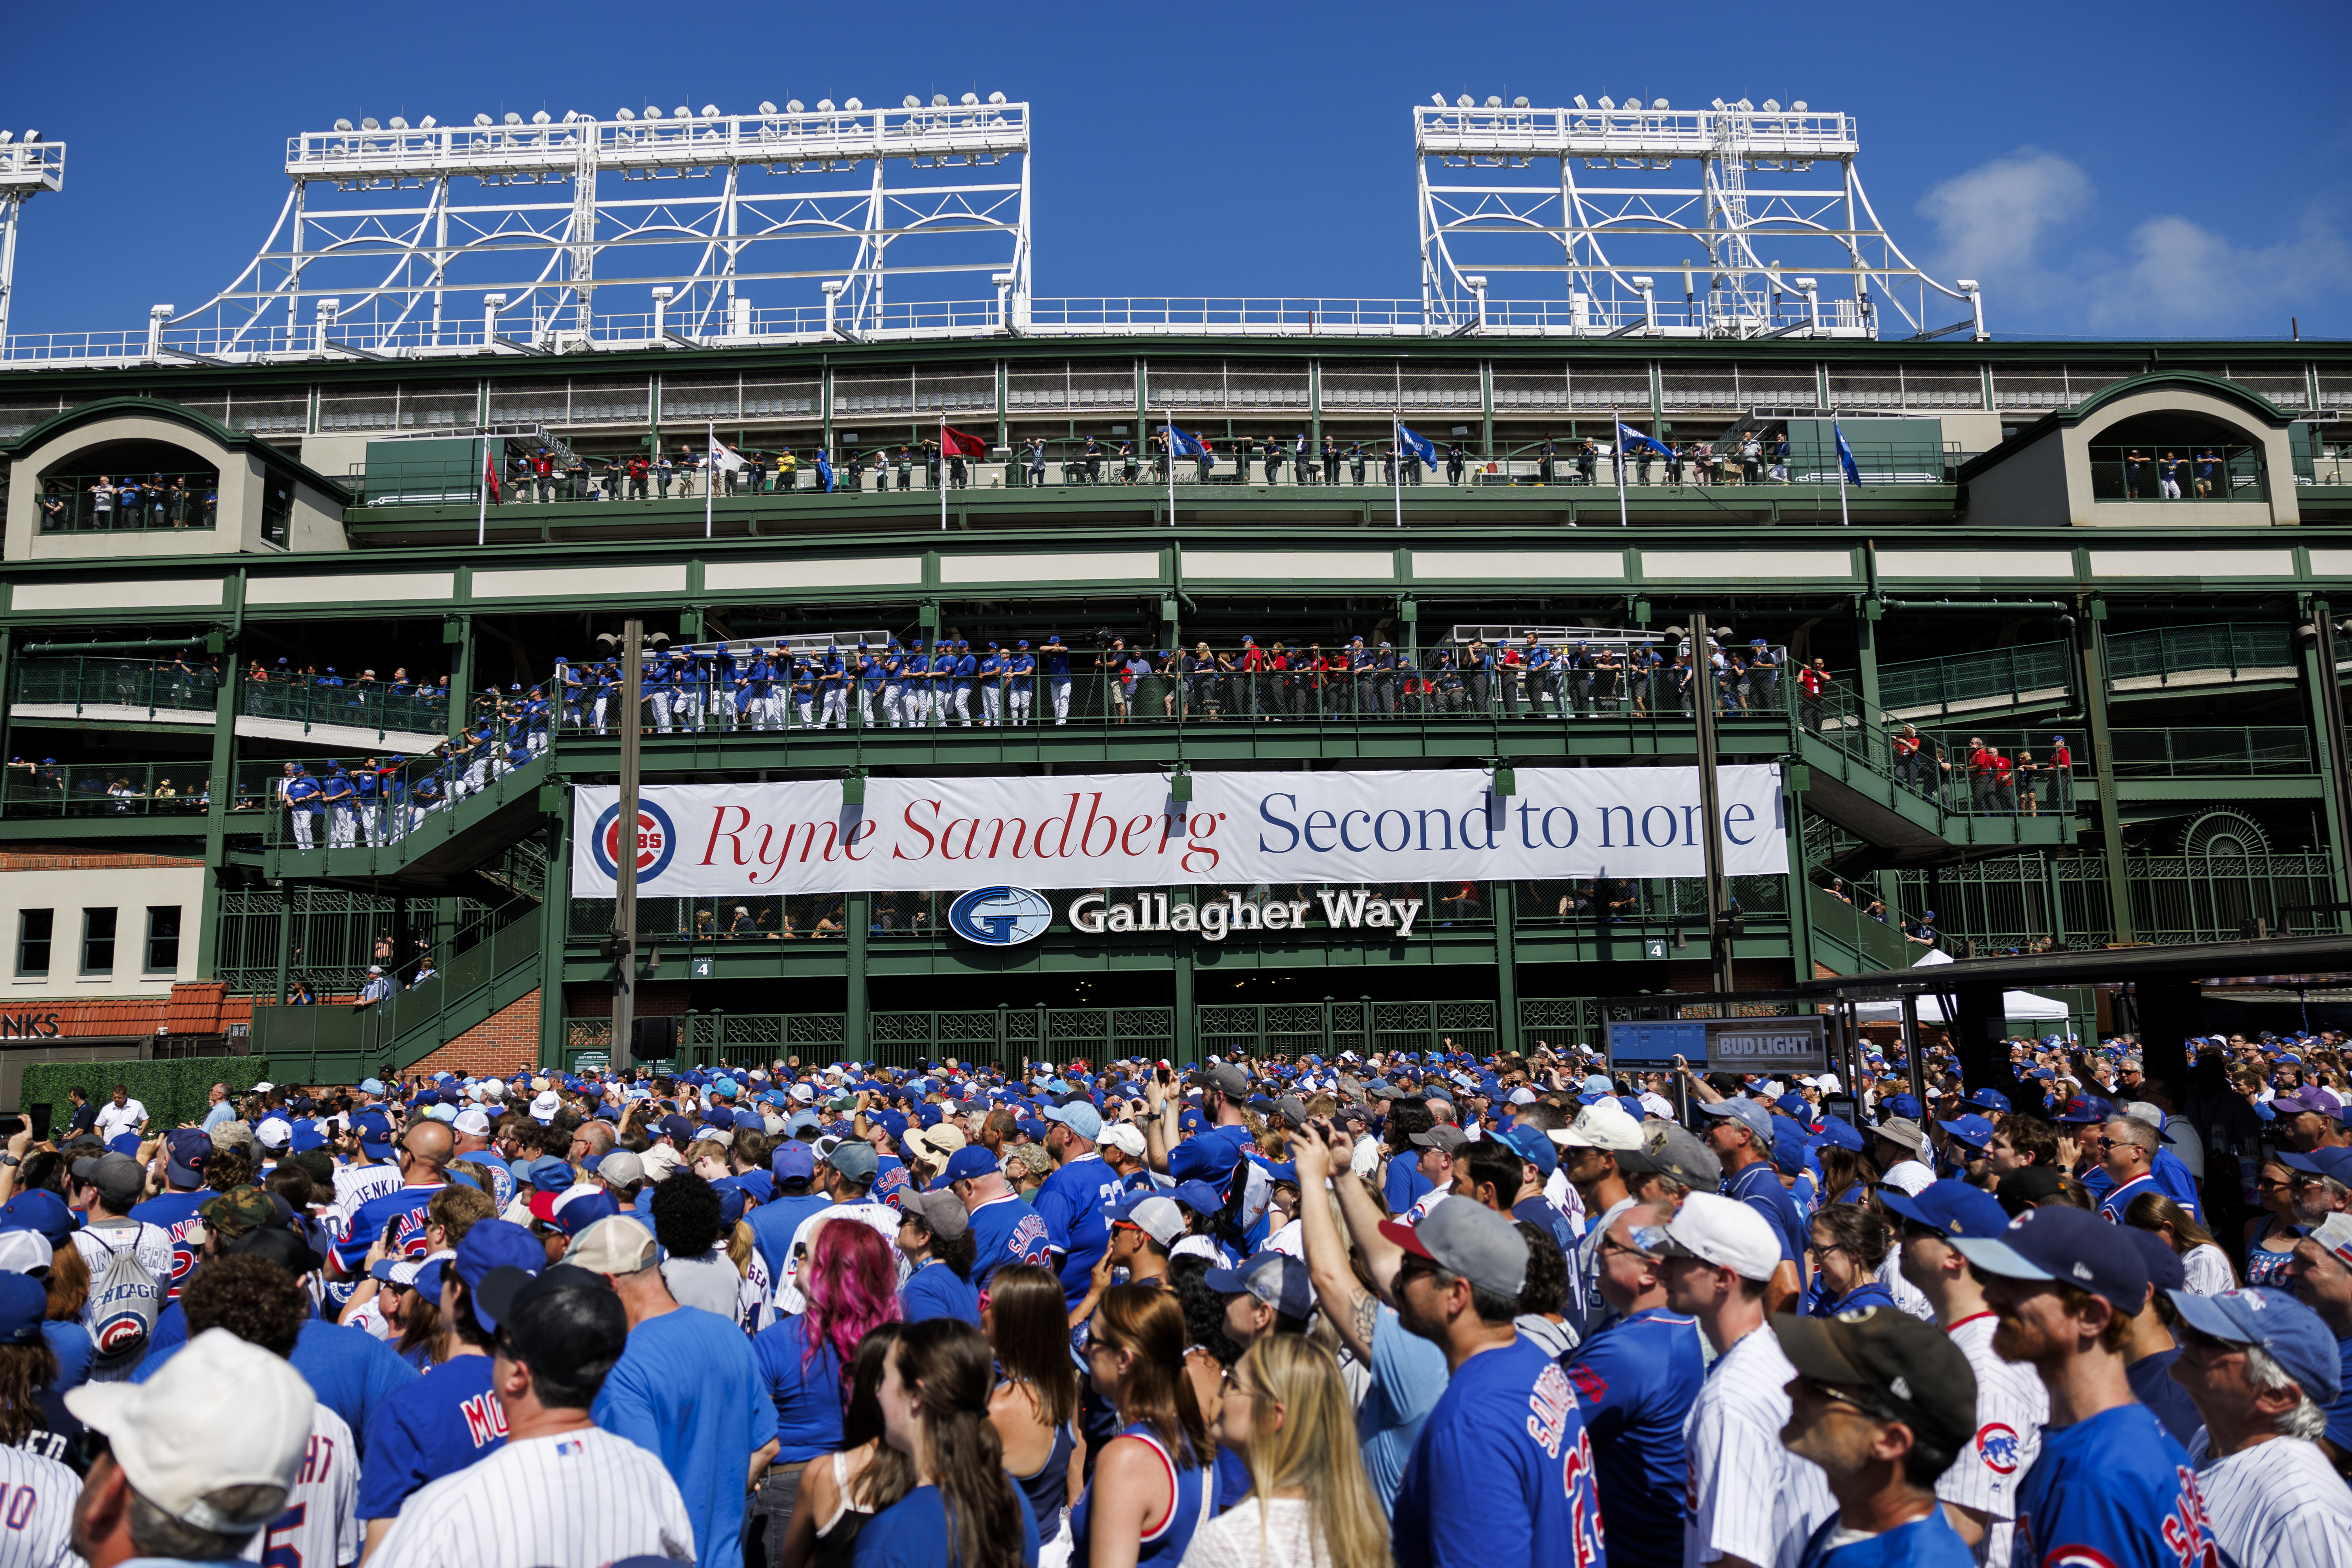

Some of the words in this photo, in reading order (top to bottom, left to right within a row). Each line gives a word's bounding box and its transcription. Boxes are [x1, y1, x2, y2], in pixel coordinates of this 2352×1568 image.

[541, 427, 563, 455] BEER
[701, 806, 875, 884] Ryne
[892, 793, 1226, 873] Sandberg
[1260, 791, 1501, 853] Second
[1516, 798, 1579, 849] to
[1069, 892, 1310, 941] Gallagher
[1317, 889, 1424, 937] Way
[1651, 945, 1662, 957] 4
[697, 963, 708, 975] 4
[0, 1013, 59, 1038] NKS
[1720, 1038, 1755, 1055] BUD
[1757, 1037, 1809, 1054] LIGHT
[189, 1156, 202, 1168] C
[83, 1245, 168, 1274] ANERG
[93, 1283, 158, 1310] CHICAGO
[332, 1285, 346, 1302] ALL-STAR
[1569, 1368, 1605, 1403] CUBS
